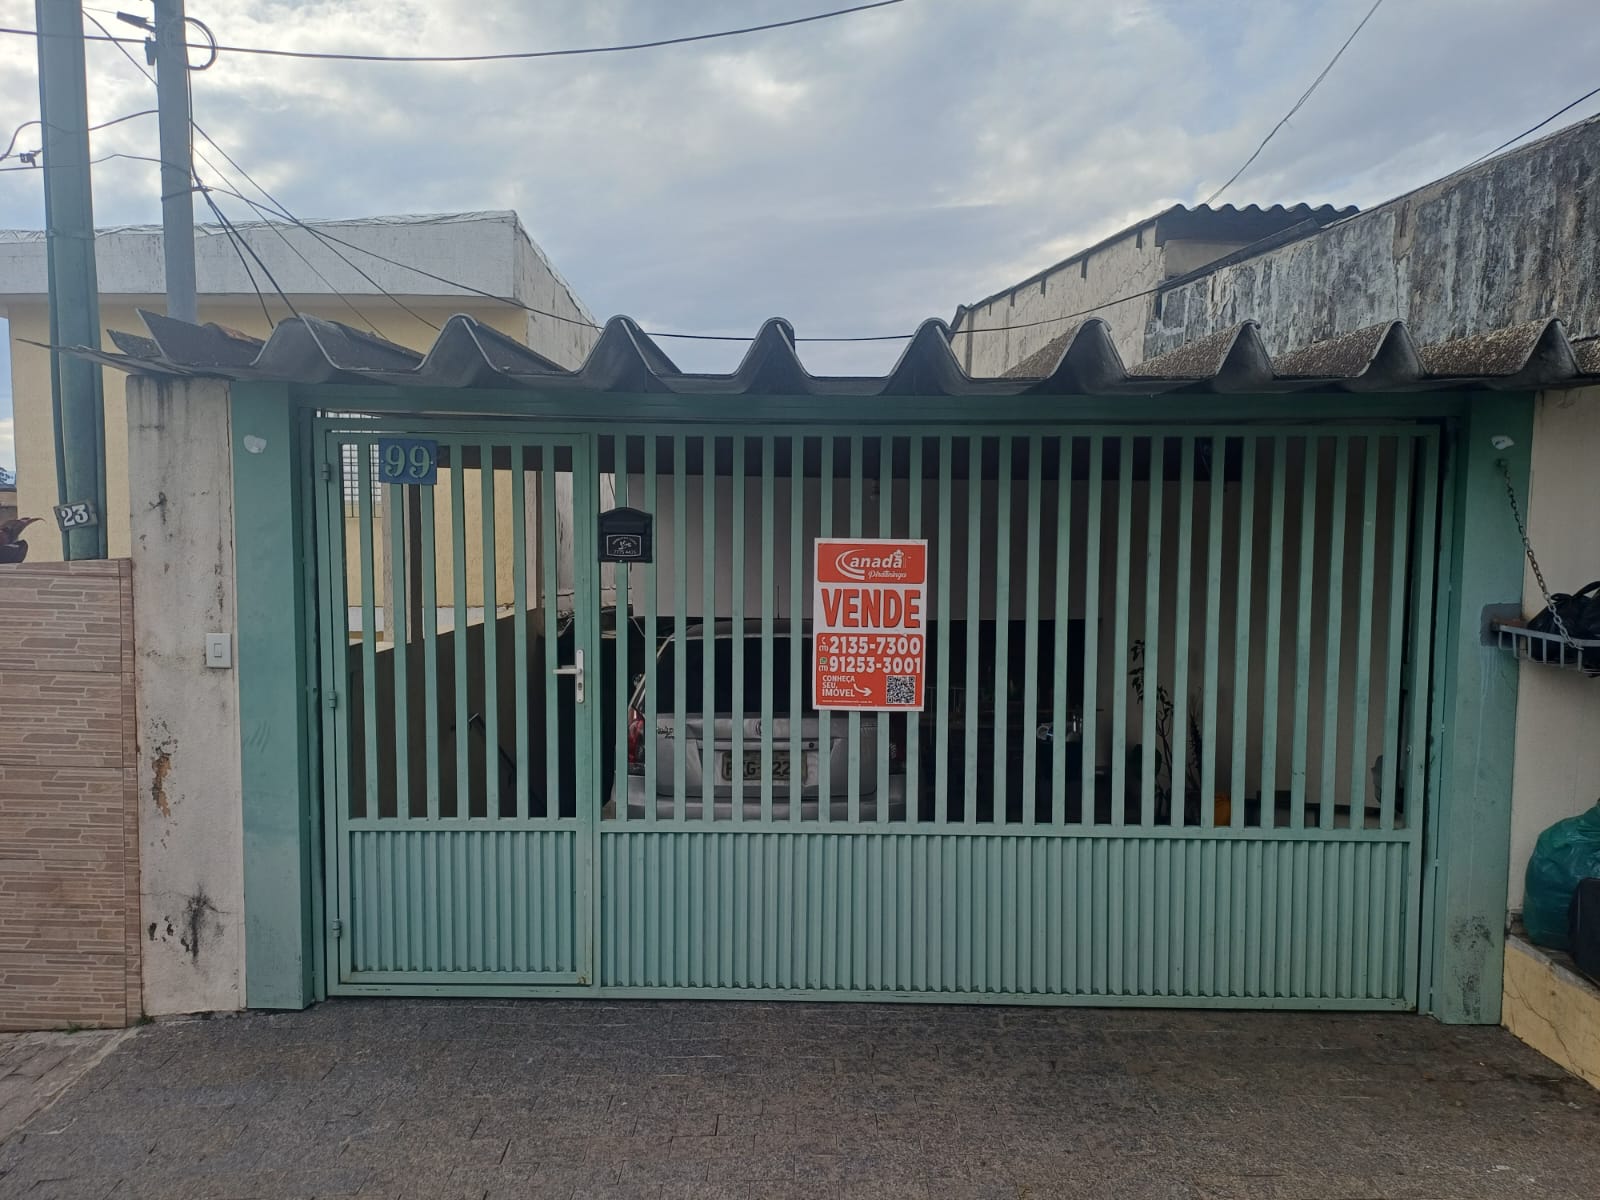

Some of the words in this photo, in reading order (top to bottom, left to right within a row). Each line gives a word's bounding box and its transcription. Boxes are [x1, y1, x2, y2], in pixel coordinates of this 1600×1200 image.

[385, 444, 431, 479] 99
[61, 504, 89, 527] 23
[821, 588, 921, 628] VENDE
[829, 635, 921, 655] 2135-7300
[829, 655, 921, 674] 91253-3001
[822, 674, 856, 684] CONHEÇA
[822, 681, 836, 689] SEU
[821, 686, 856, 698] IMÓVEL
